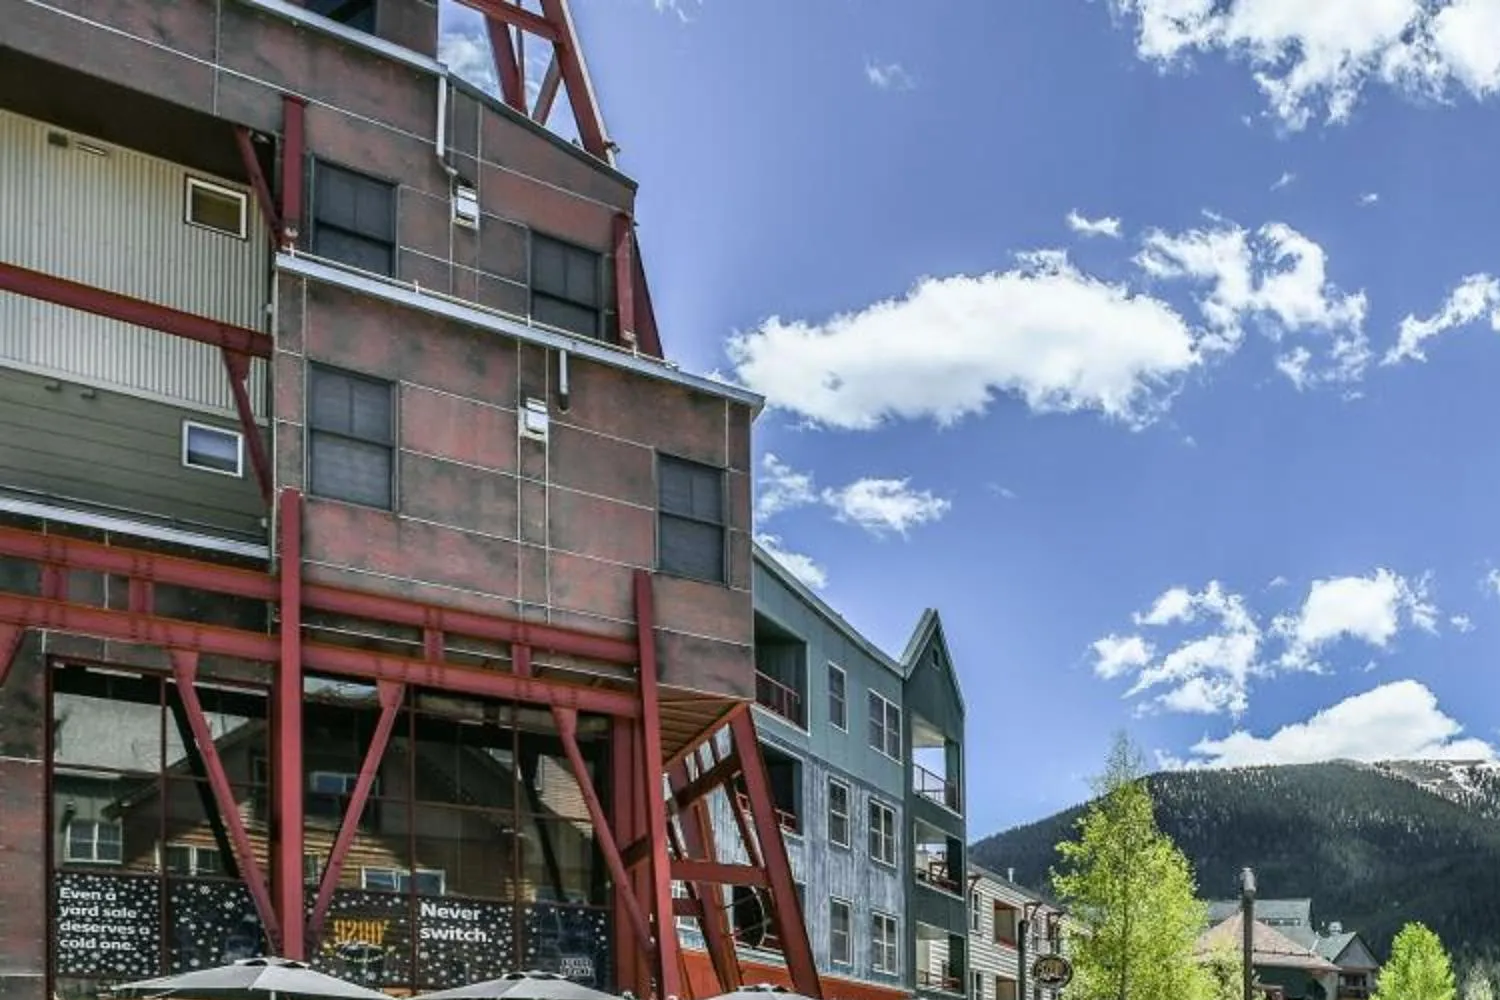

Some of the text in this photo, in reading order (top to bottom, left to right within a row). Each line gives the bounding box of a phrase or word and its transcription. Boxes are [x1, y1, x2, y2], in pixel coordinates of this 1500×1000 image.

[60, 887, 117, 901] Even a
[60, 905, 137, 919] yard sale
[420, 902, 482, 921] Never
[60, 921, 151, 935] deserves a
[419, 925, 493, 943] switch.
[60, 938, 137, 951] cold one.
